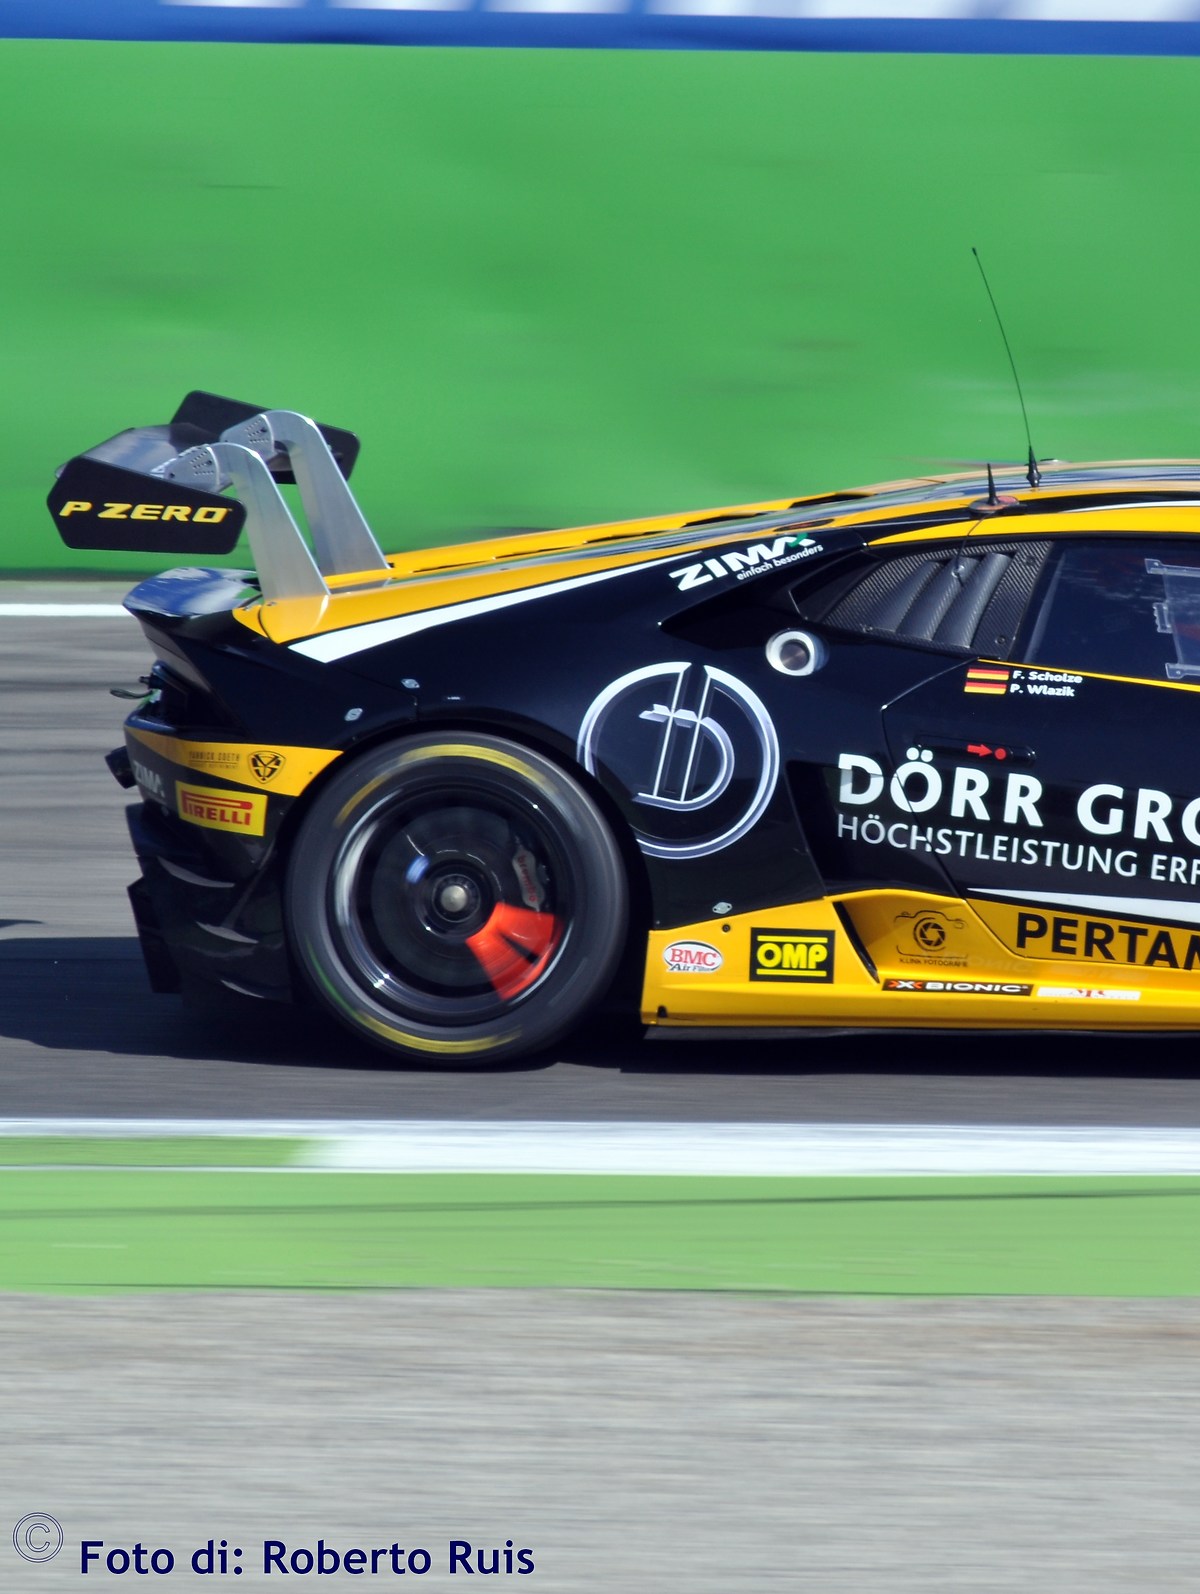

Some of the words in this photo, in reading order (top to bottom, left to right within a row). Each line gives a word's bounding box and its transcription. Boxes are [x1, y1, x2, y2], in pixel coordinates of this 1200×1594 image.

[59, 501, 92, 517] P
[97, 503, 229, 523] ZERO
[736, 563, 773, 580] einfach
[773, 544, 824, 567] besonders
[1010, 683, 1023, 693] P.
[1027, 684, 1075, 697] Wlazik
[1012, 670, 1025, 680] F.
[1028, 671, 1083, 684] Scholze
[838, 747, 1043, 828] DÖRR
[180, 790, 253, 825] PIRELLI
[837, 814, 1138, 877] HÖCHSTLEISTUNG
[670, 948, 717, 967] BMC
[757, 943, 827, 969] OMP
